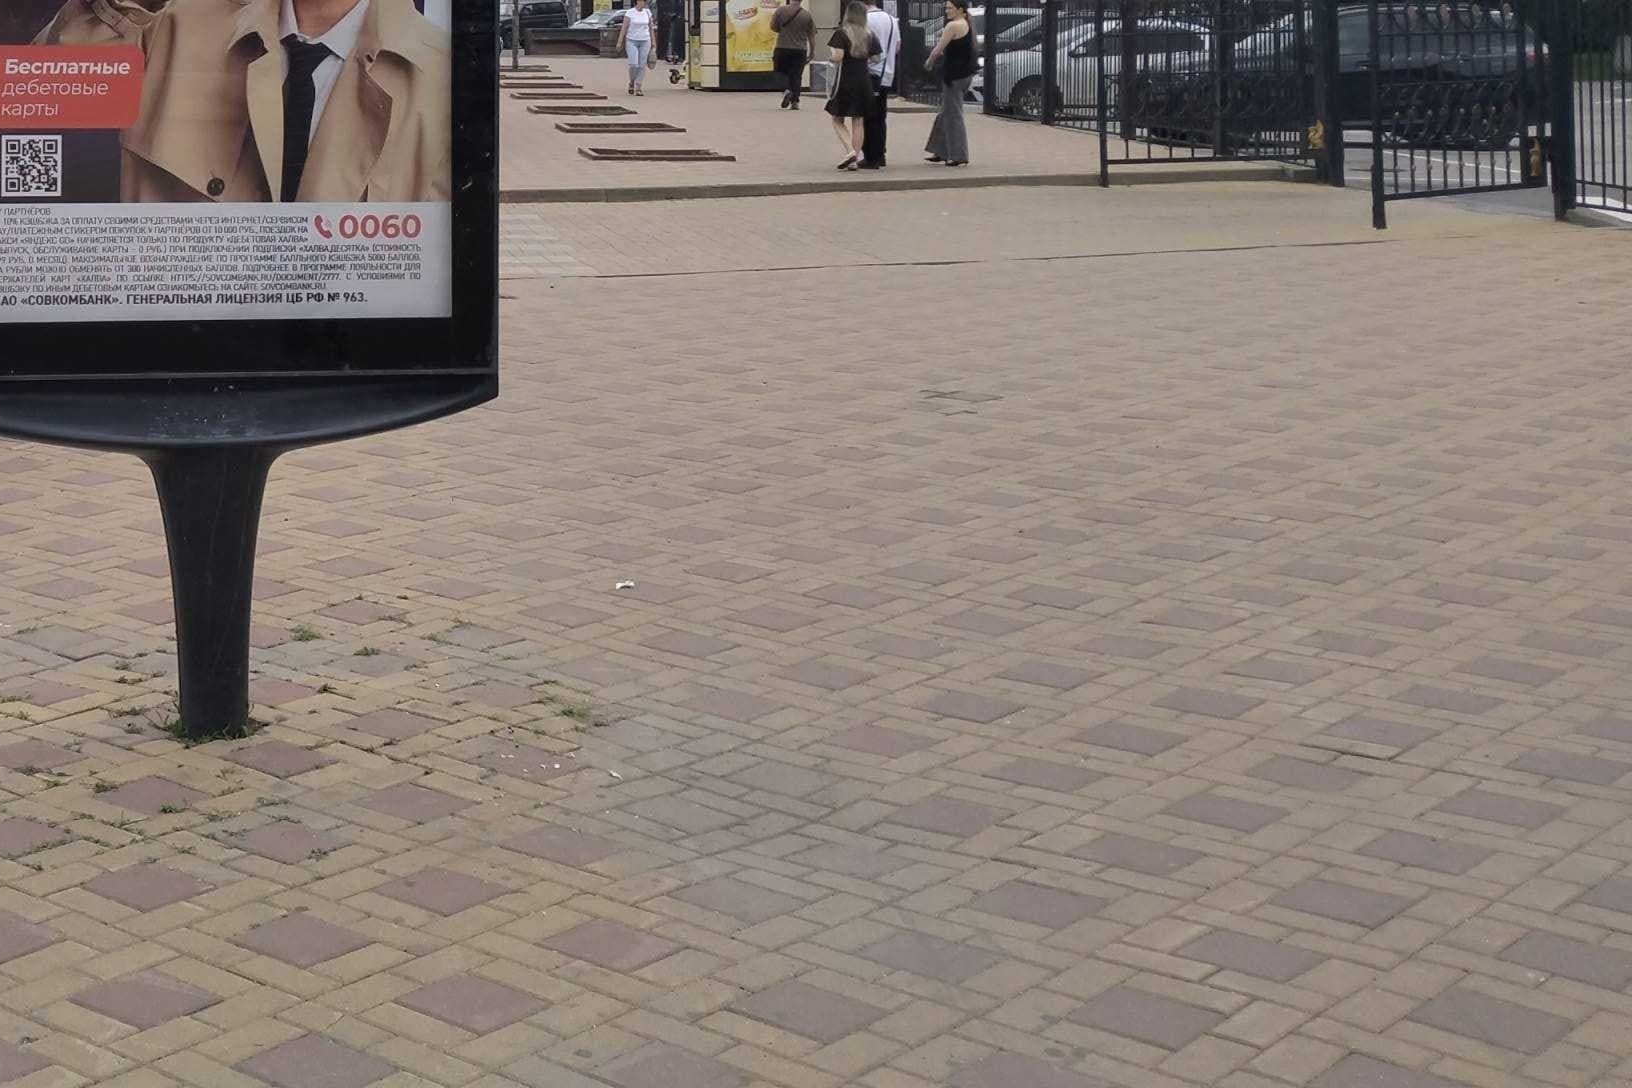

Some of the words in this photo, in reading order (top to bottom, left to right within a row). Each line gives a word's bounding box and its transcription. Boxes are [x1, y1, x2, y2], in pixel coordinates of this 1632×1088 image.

[5, 58, 130, 75] Бесплатные
[1, 79, 109, 98] дебетовые
[1, 101, 59, 119] карты
[339, 214, 422, 239] 0060
[20, 293, 122, 305] «СОВКОМБАНК».
[126, 293, 212, 304] ГЕНЕРАЛЬНАЯ
[215, 292, 282, 304] ЛИЦЕНЗИЯ
[285, 292, 303, 303] ЦБ
[305, 292, 324, 303] РФ
[342, 292, 367, 303] 963.
